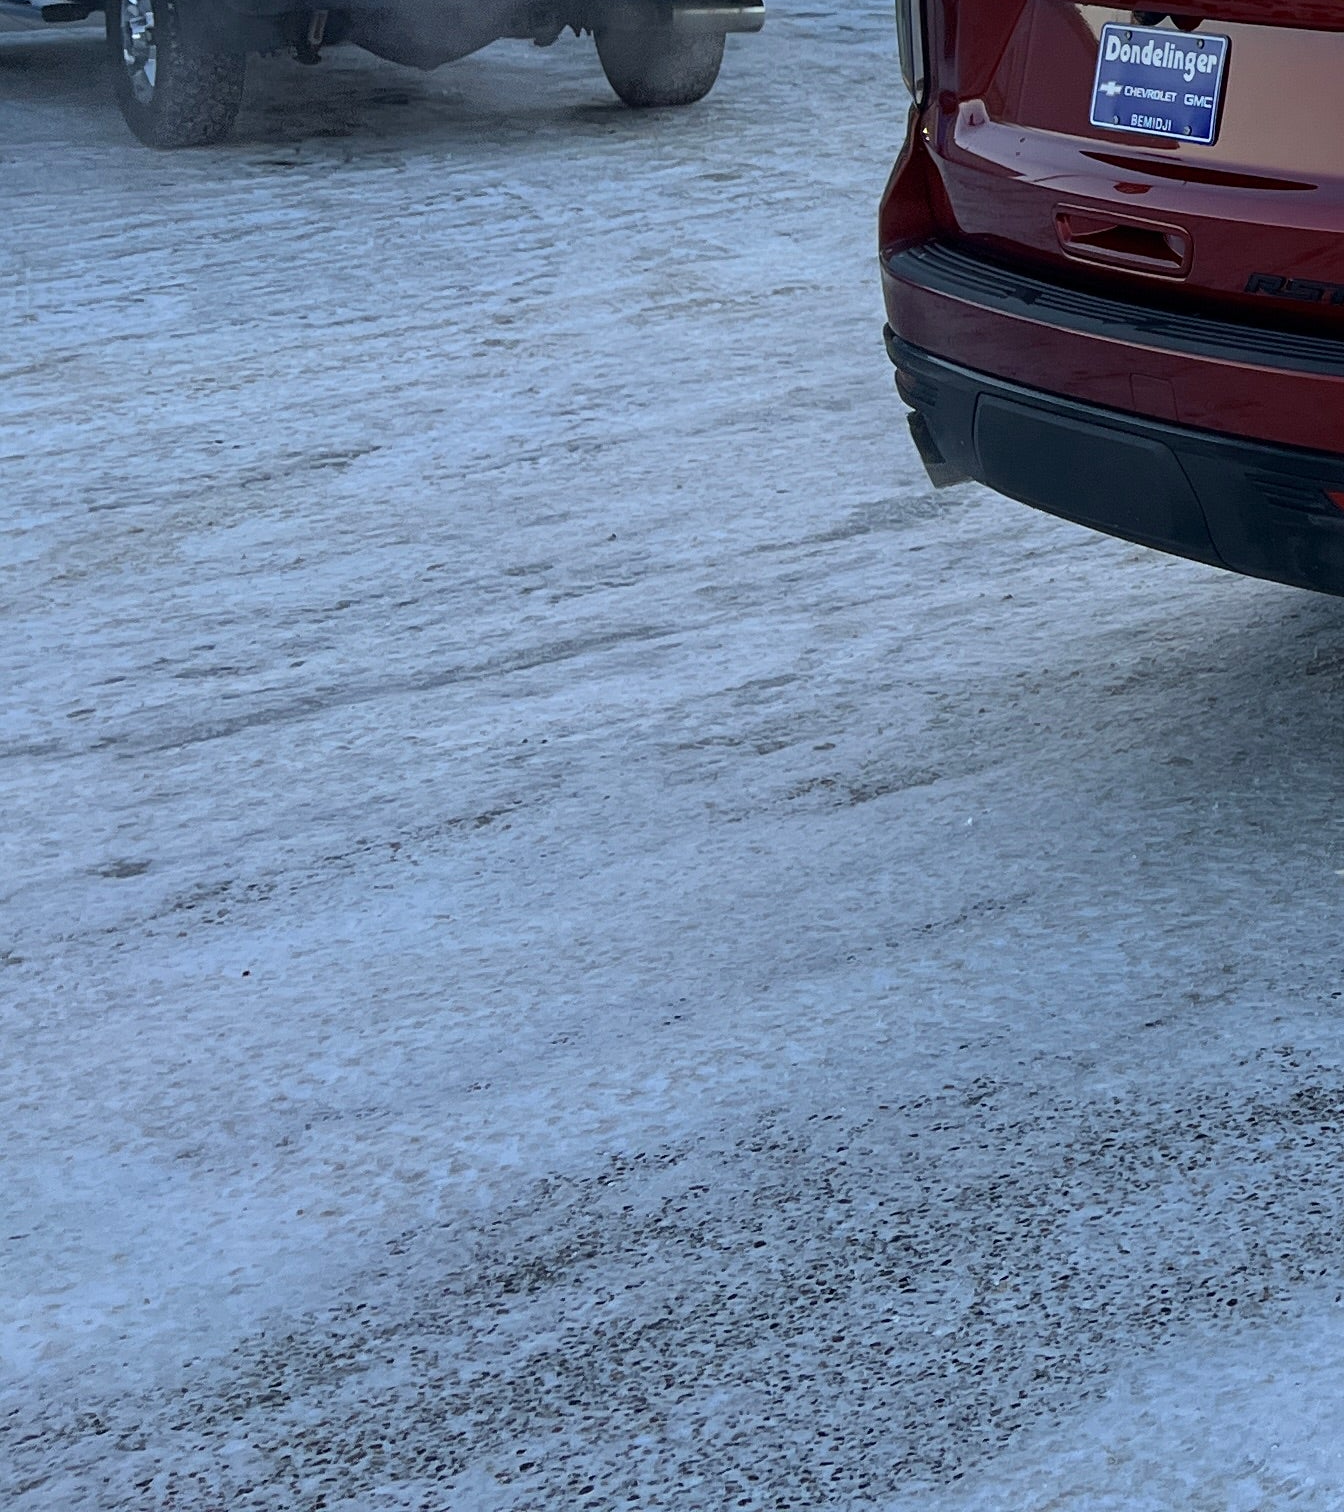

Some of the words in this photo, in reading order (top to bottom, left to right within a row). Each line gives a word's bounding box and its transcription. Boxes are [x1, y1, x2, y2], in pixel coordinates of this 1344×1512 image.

[1104, 34, 1218, 82] Dondelinger
[1124, 85, 1178, 103] CHEVROLET
[1183, 93, 1213, 109] GMC
[1130, 113, 1172, 132] BEMIDJI
